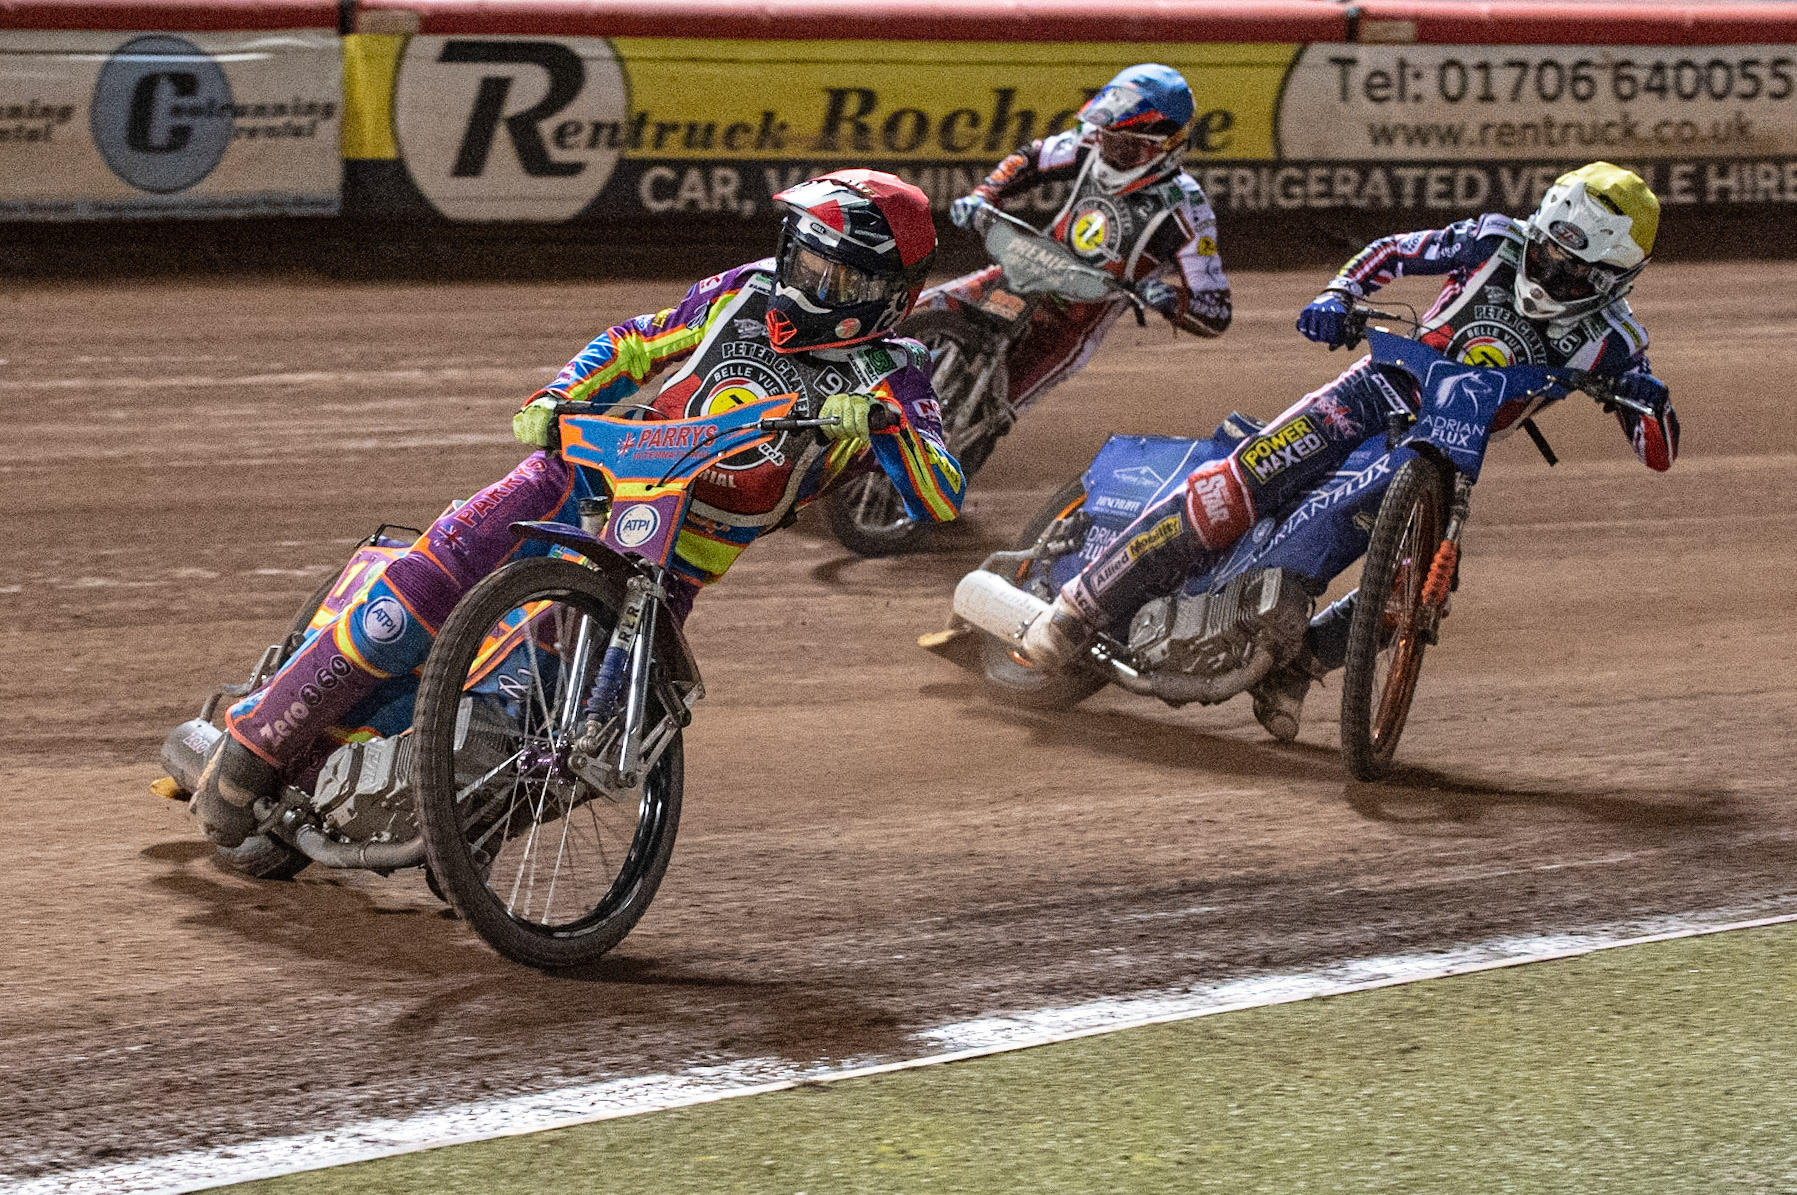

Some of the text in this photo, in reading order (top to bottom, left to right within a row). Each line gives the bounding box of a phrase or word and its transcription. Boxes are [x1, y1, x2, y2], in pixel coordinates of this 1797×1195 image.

[1328, 56, 1795, 103] Tel: 01706 640055
[820, 86, 1235, 154] Roche
[1367, 110, 1754, 149] www.rentruck.co.uk
[1194, 165, 1489, 211] FRIGERATED
[1499, 165, 1697, 208] VELE
[721, 341, 776, 366] PETER
[1466, 326, 1522, 353] BELLE VUE
[713, 366, 780, 395] BELLE VUE
[636, 425, 718, 449] PARRYS
[1421, 415, 1486, 437] ADRIAN
[1430, 427, 1469, 448] FLUX
[1244, 420, 1312, 467] POWER
[1254, 433, 1322, 480] MAXED
[454, 458, 547, 528] PARRYS
[622, 518, 651, 533] ATPI
[1097, 519, 1178, 586] Allied Mobility
[373, 606, 397, 634] ATPI
